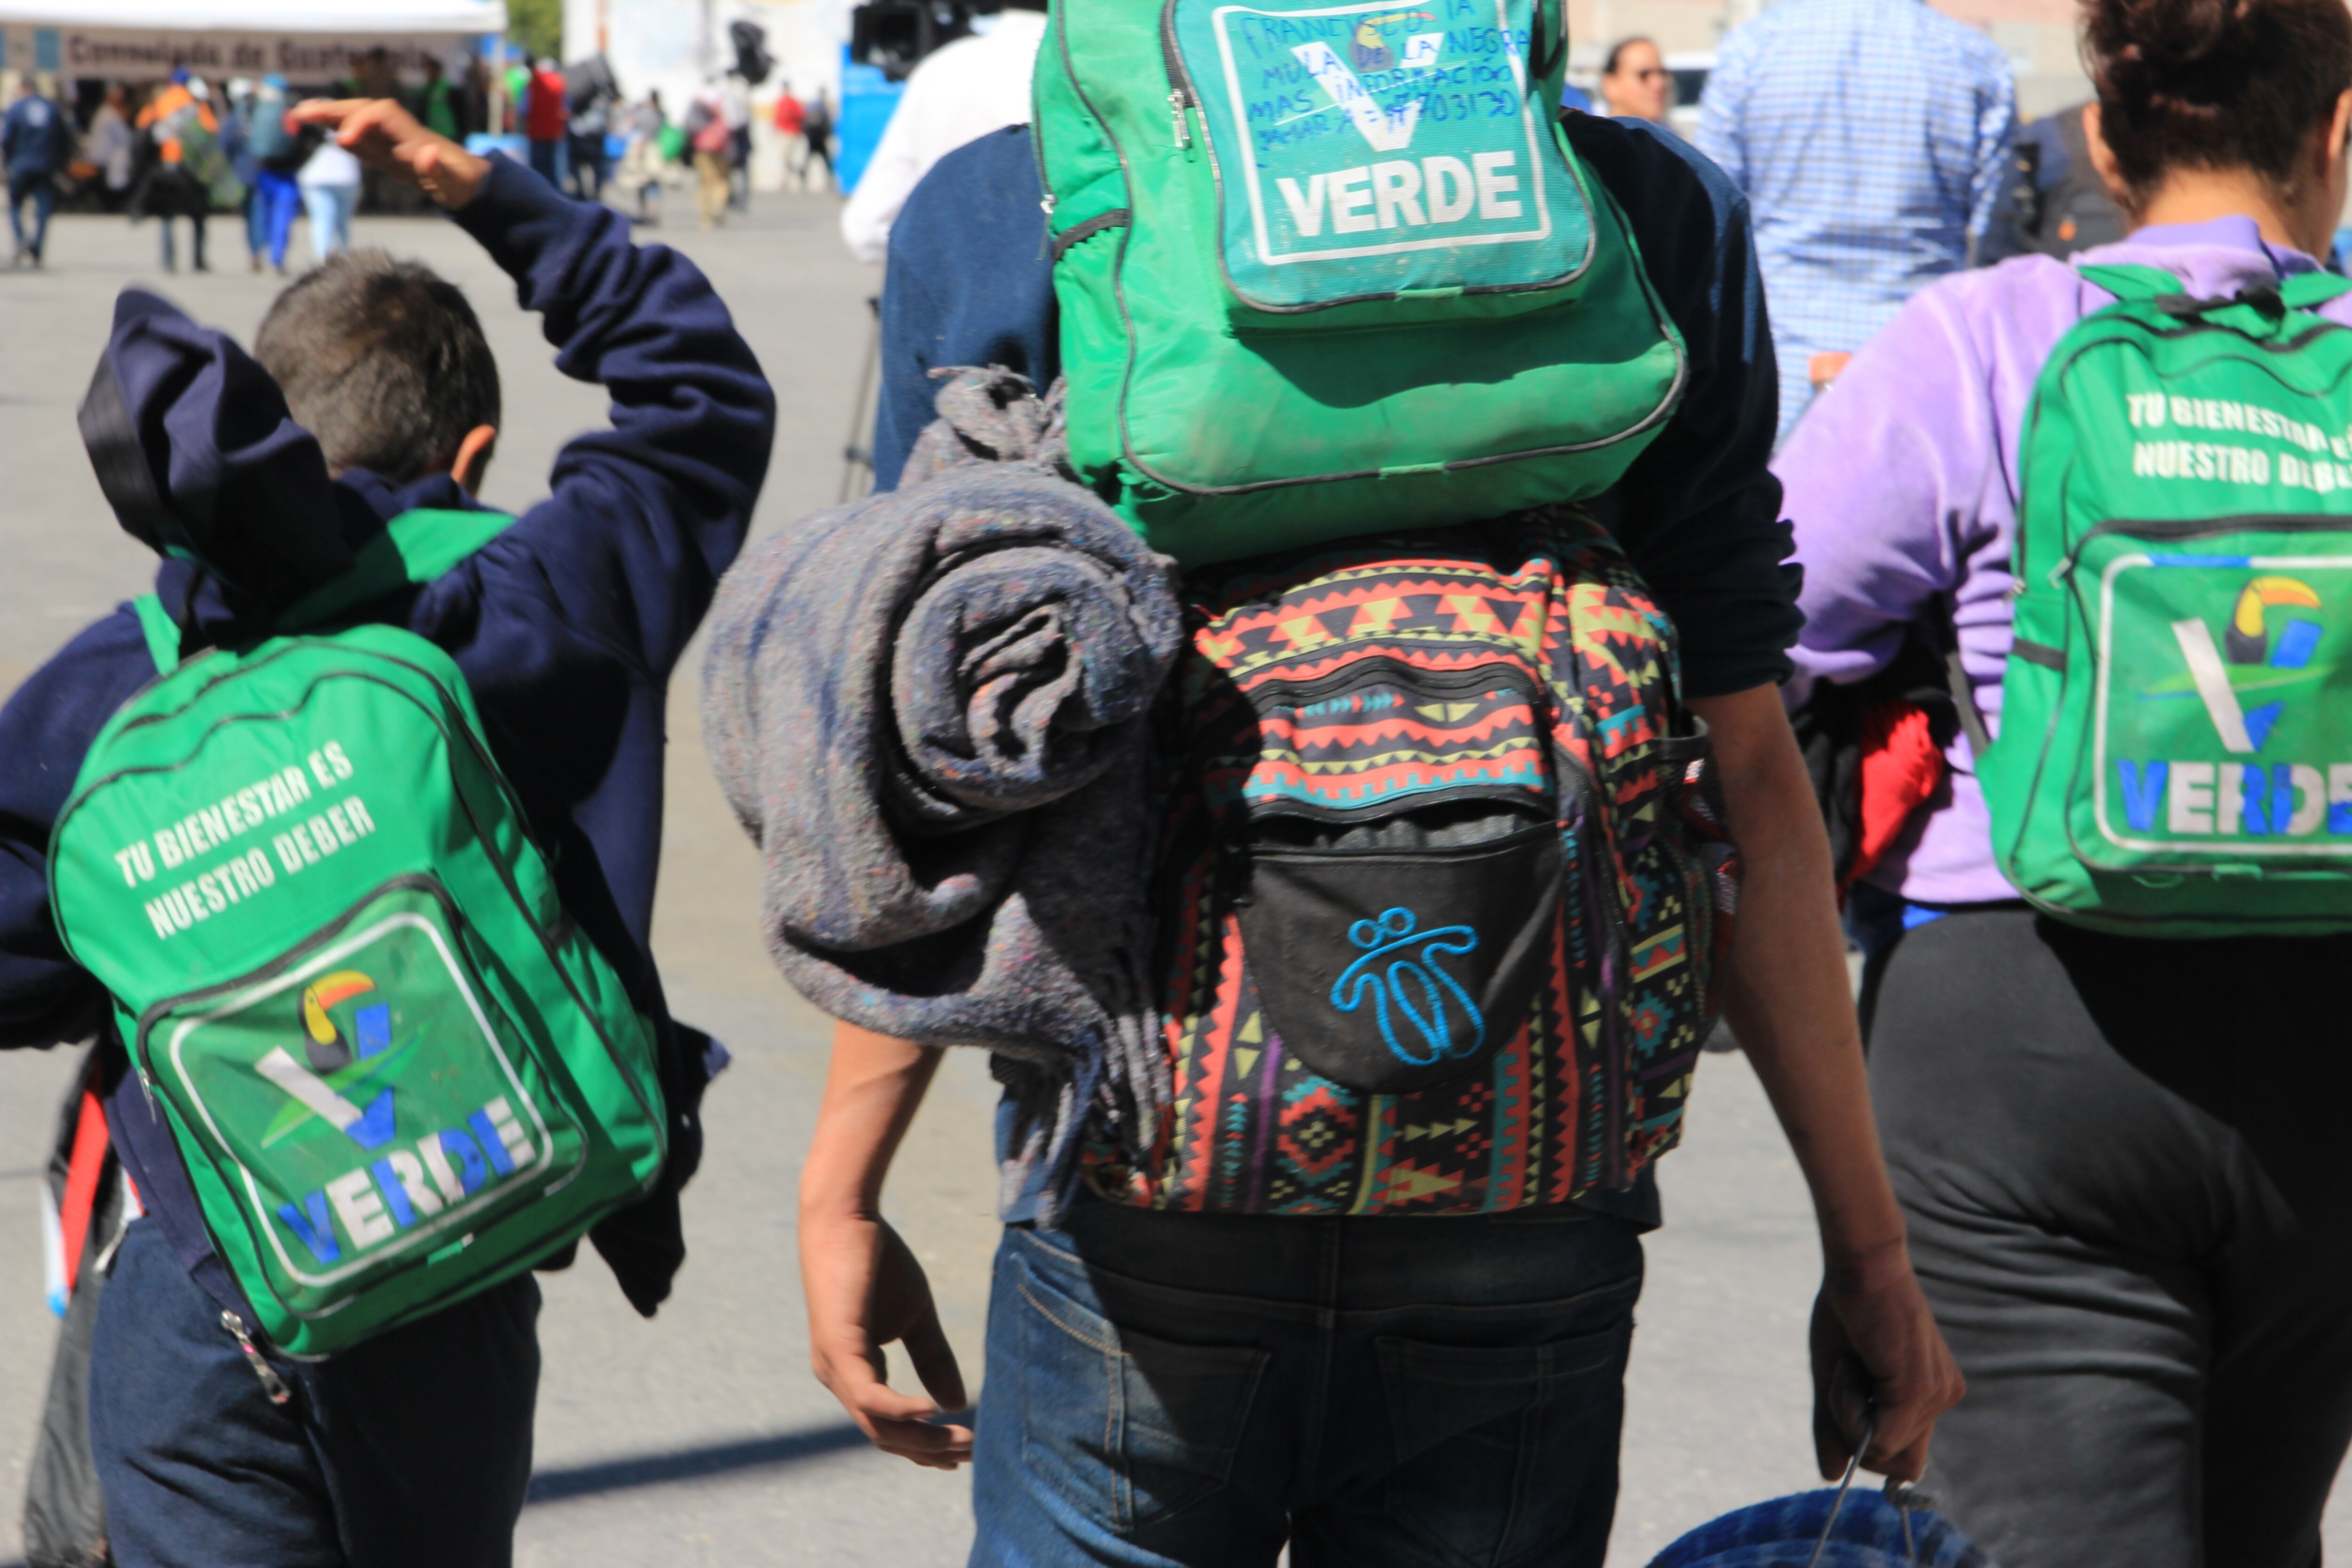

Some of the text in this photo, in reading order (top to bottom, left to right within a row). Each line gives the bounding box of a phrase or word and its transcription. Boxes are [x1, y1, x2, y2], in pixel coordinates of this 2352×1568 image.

[1275, 151, 1523, 237] VERDE
[2126, 392, 2166, 428] TU
[2169, 395, 2329, 452] BIENESTAR
[2133, 441, 2352, 494] NUESTRO DEBE
[114, 739, 354, 889] TU BIENESTAR ES
[144, 795, 376, 940] NUESTRO DEBER
[276, 1095, 537, 1265] VERDE
